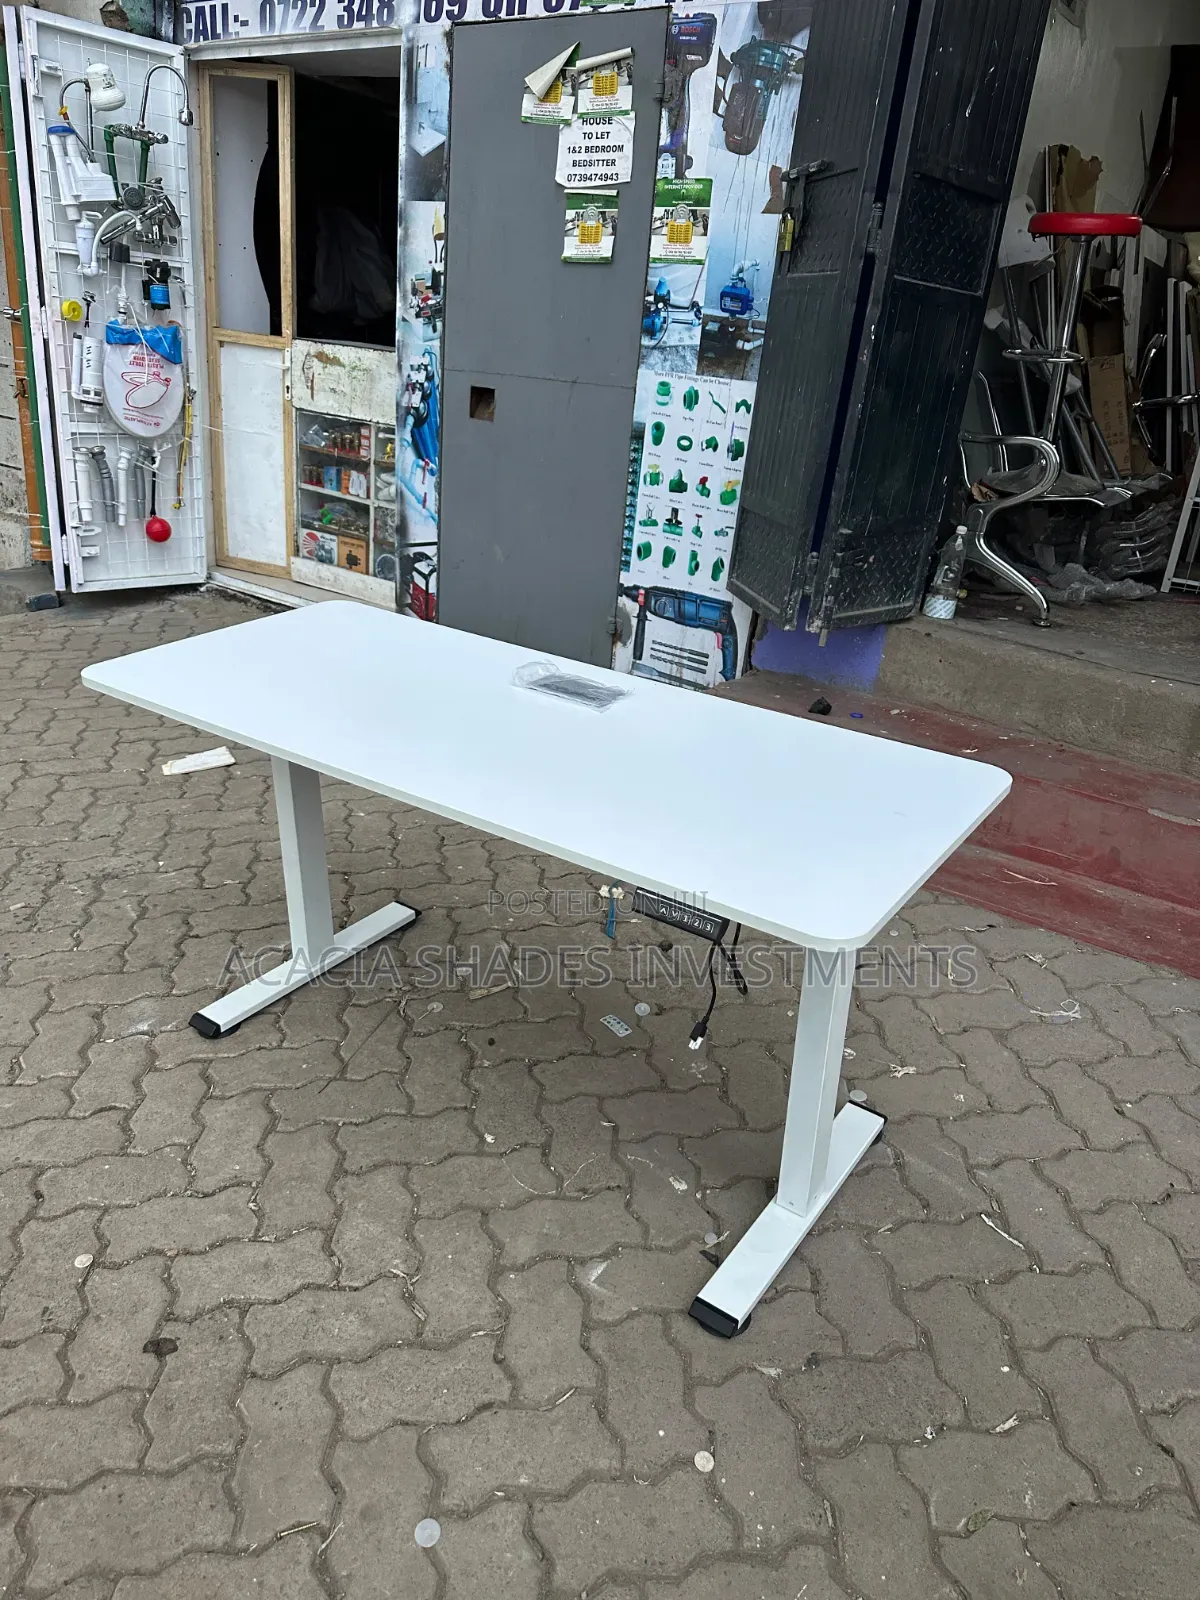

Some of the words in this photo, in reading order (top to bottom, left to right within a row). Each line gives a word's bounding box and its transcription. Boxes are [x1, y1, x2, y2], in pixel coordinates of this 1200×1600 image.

[258, 0, 326, 36] 0722
[336, 0, 395, 29] 348
[680, 25, 701, 33] BOSCH
[582, 117, 613, 126] HOUSE
[583, 132, 594, 140] TO
[595, 131, 611, 140] LET
[567, 146, 582, 154] 1&2
[584, 144, 624, 153] BEDROOM
[572, 159, 617, 168] BEDSITTER
[567, 173, 619, 182] 0739474943
